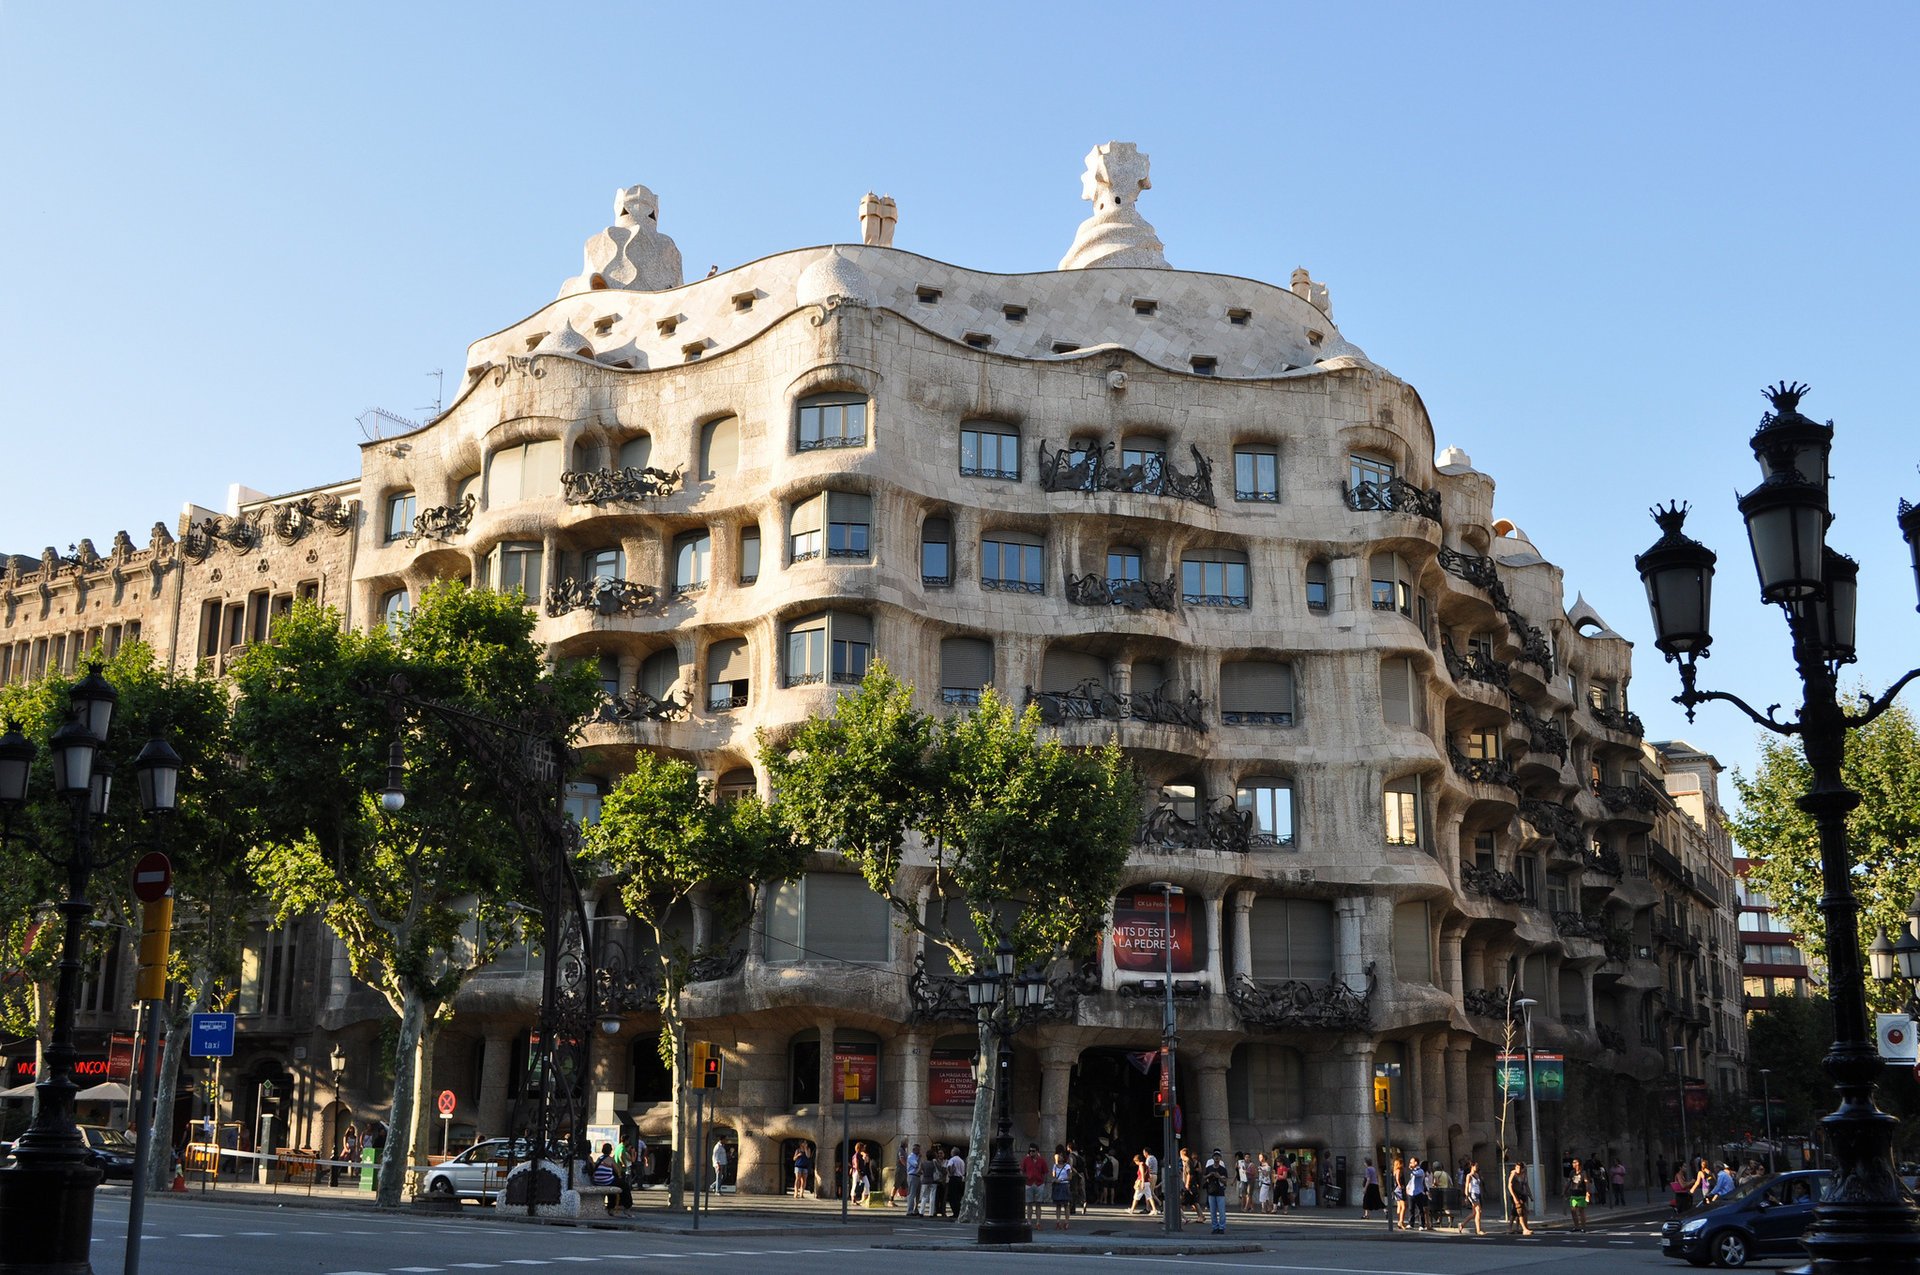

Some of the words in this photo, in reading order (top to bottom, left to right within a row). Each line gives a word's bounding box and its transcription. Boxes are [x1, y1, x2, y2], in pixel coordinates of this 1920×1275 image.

[1113, 926, 1136, 937] NITS
[1138, 927, 1176, 939] D'ESTU
[1119, 938, 1132, 948] LA
[204, 1041, 220, 1049] taxi
[17, 1061, 36, 1075] VINÇ
[74, 1061, 110, 1075] VINÇON
